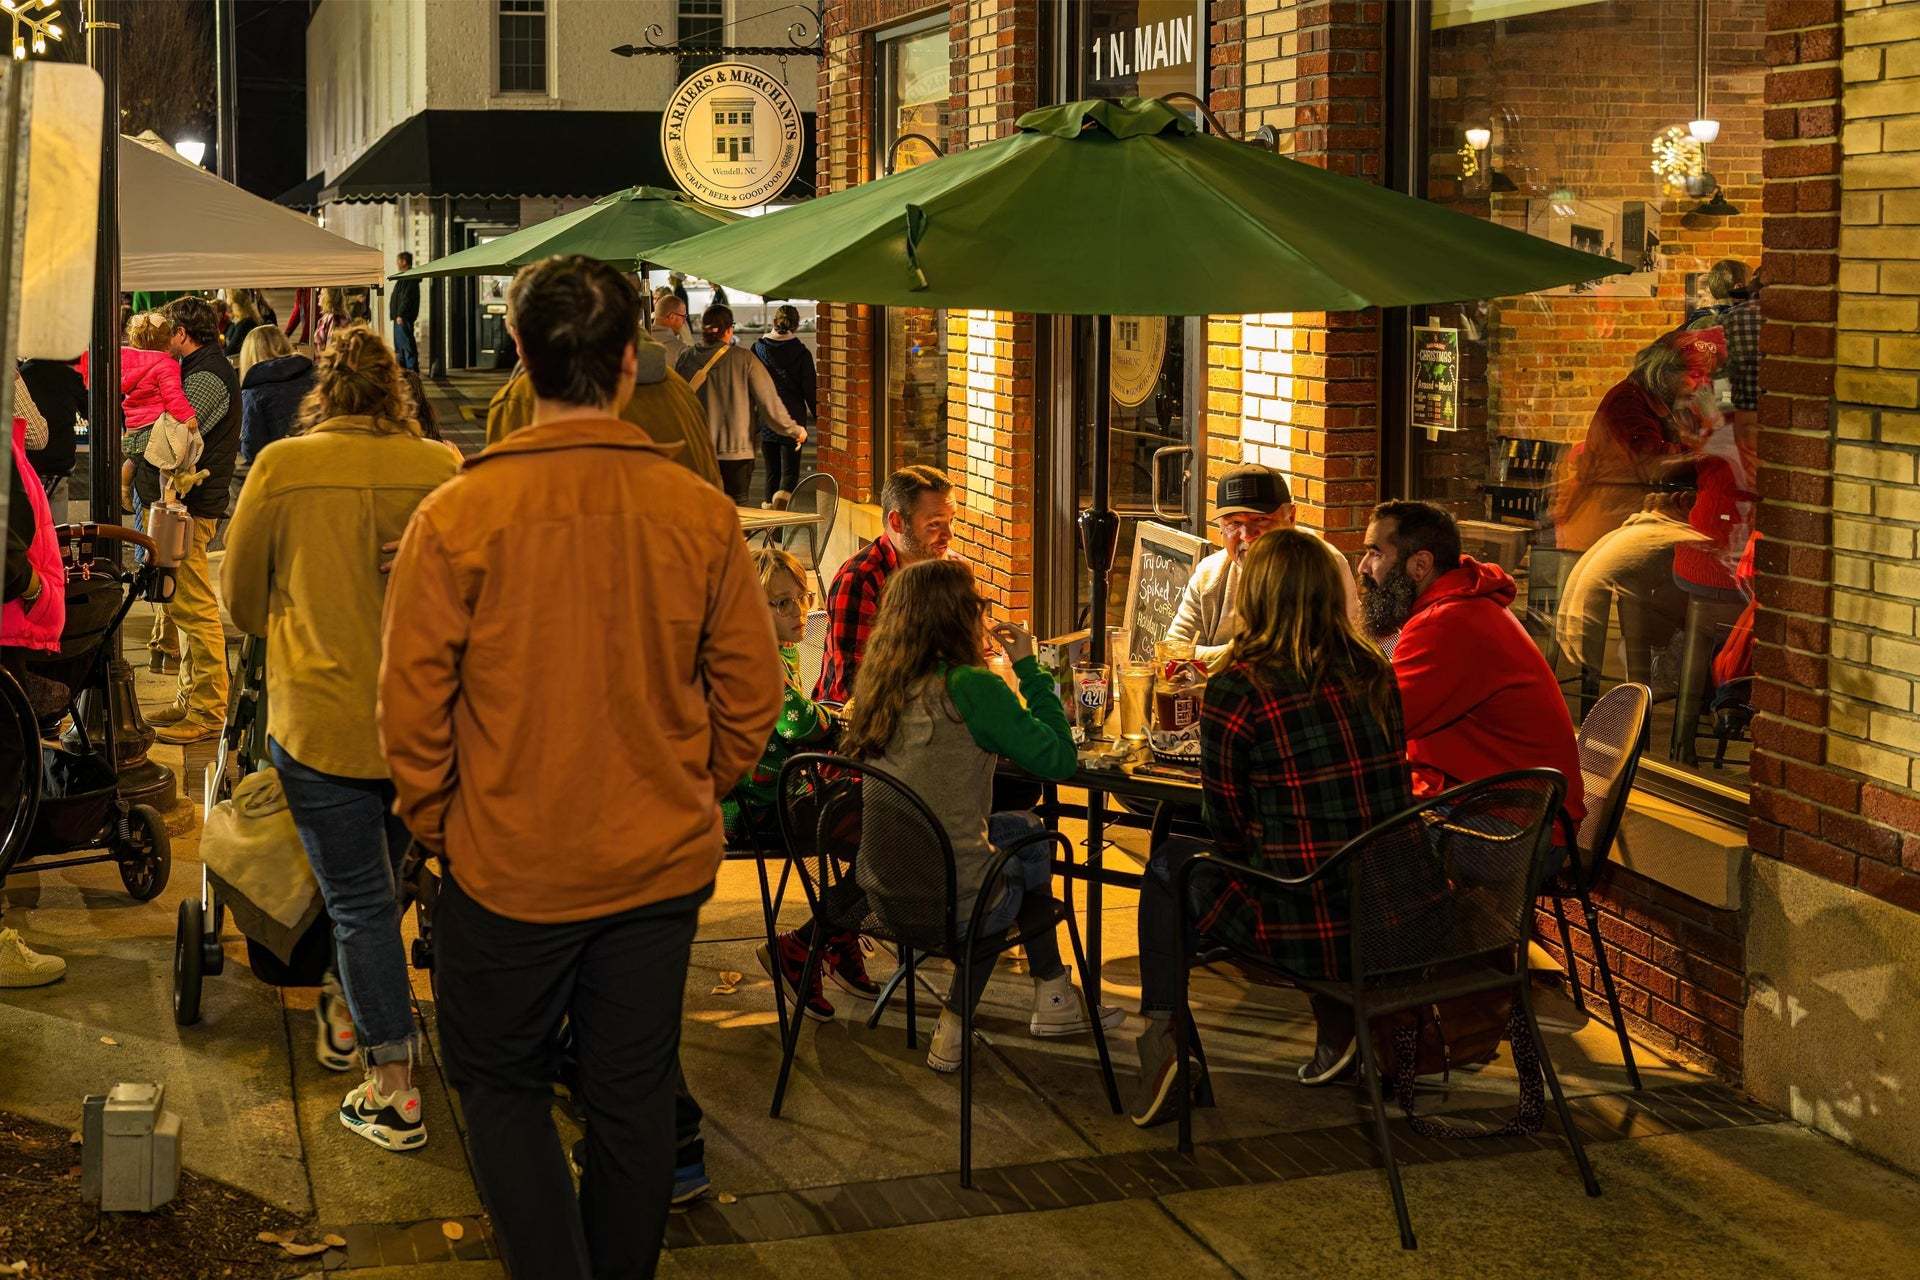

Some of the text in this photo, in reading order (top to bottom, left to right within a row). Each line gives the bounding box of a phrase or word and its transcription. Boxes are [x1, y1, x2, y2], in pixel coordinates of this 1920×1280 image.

[1092, 14, 1192, 81] 1 N. MAIN
[668, 69, 798, 141] FARMERS & MERCHANTS
[744, 167, 757, 175] NC
[685, 170, 784, 201] CRAFT BEER GOOD FOOD
[1419, 350, 1452, 363] CHRISTMAS
[1141, 552, 1155, 582] Try
[1138, 577, 1170, 603] Spiked
[1084, 689, 1105, 705] 420
